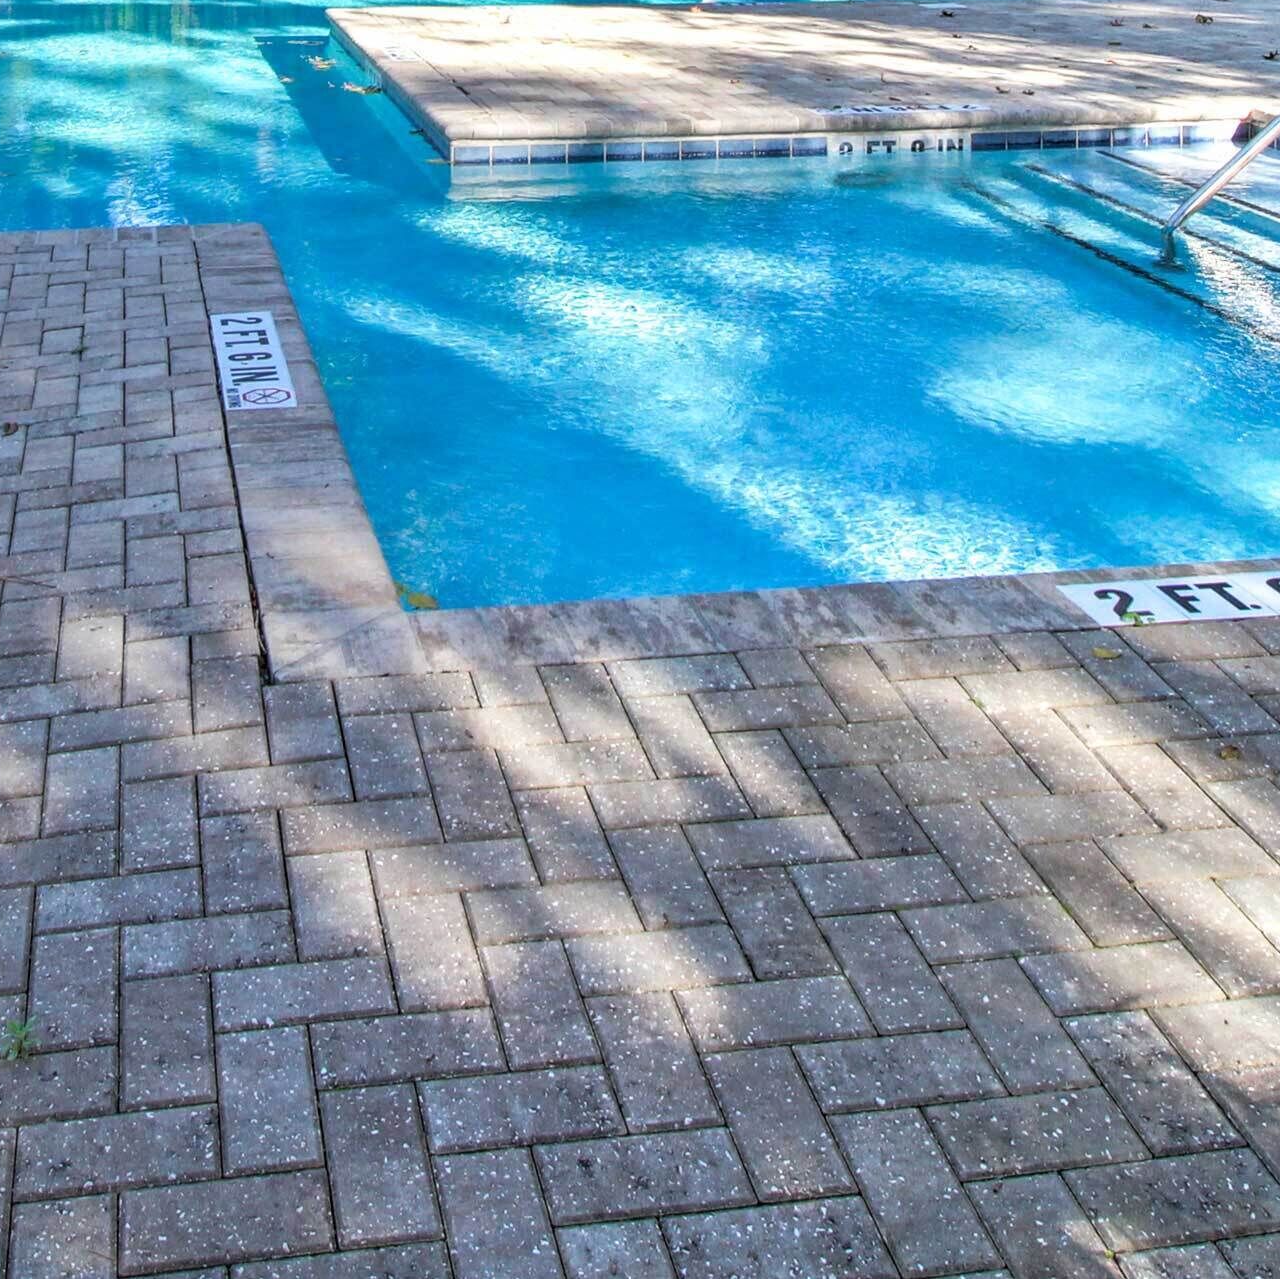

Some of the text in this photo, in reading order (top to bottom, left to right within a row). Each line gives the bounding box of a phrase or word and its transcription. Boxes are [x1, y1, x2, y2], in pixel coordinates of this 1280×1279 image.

[221, 317, 262, 326] 2
[228, 352, 272, 362] 6
[1094, 589, 1154, 619] 2
[1155, 581, 1262, 614] FT.
